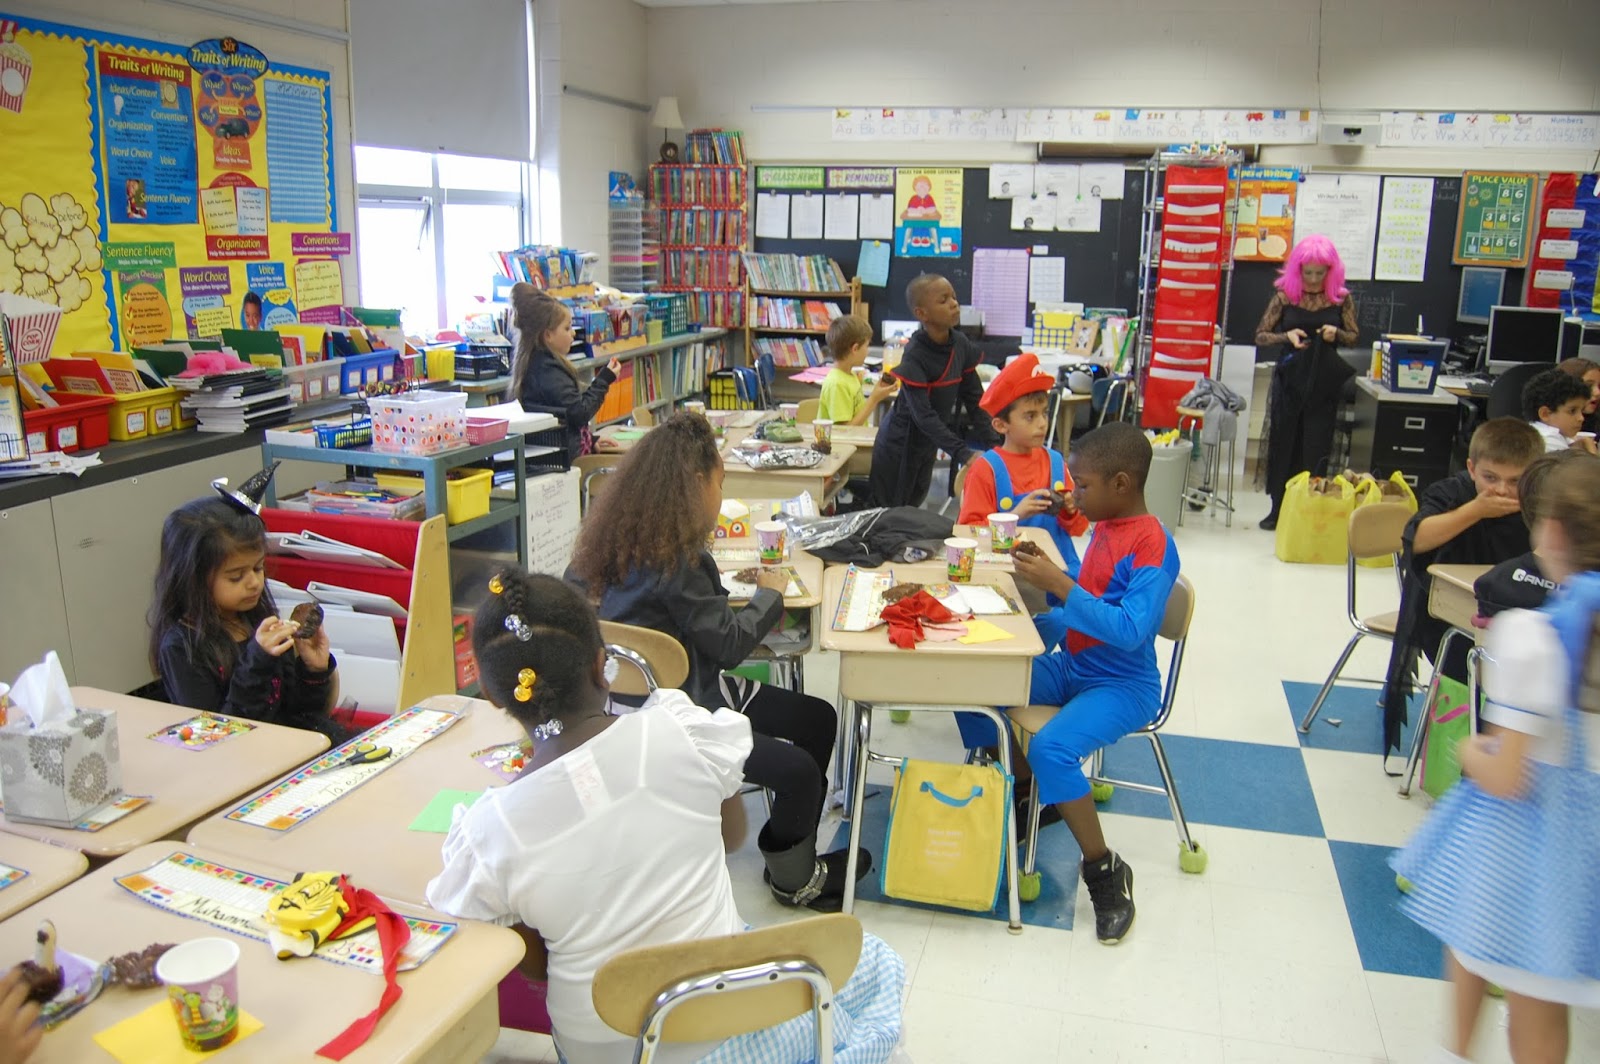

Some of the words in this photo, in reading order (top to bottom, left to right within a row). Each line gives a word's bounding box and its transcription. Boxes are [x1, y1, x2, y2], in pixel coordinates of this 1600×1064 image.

[223, 37, 236, 52] Six
[192, 48, 220, 65] Traits
[222, 54, 230, 68] of
[231, 54, 266, 72] Writing
[108, 55, 140, 72] Traits
[141, 64, 150, 75] of
[151, 62, 185, 82] Writing
[204, 78, 224, 89] What?
[232, 82, 254, 92] Where?
[110, 83, 158, 98] Ideas/Content
[151, 109, 188, 122] Conventions
[1550, 116, 1583, 125] Numbers
[108, 118, 154, 132] Organization
[836, 122, 852, 135] Aa
[860, 123, 875, 135] Bb
[882, 123, 897, 135] Cc
[904, 122, 919, 135] Dd
[928, 123, 940, 135] Ee
[996, 124, 1012, 135] Hh
[1070, 125, 1083, 136] Kk
[1119, 126, 1141, 137] Mm
[1146, 126, 1162, 137] Nn
[1168, 126, 1186, 137] Oo
[1192, 126, 1208, 139] Pp
[1219, 126, 1239, 138] Qq
[1274, 126, 1287, 136] Ss
[1385, 128, 1400, 141] Uu
[1411, 129, 1427, 141] Vv
[1435, 129, 1456, 141] Ww
[1460, 129, 1479, 141] Xx
[1489, 128, 1507, 144] Yy
[1513, 128, 1530, 141] Zz
[111, 146, 128, 157] Word
[131, 148, 153, 159] Choice
[222, 144, 241, 156] Ideas
[160, 156, 176, 166] Voice
[772, 171, 797, 181] CLASS
[798, 171, 820, 181] NEWS
[845, 172, 890, 183] REMINDERS
[1233, 169, 1254, 178] Tpes
[1264, 168, 1293, 178] Writing
[1472, 176, 1499, 184] PLACE
[1501, 176, 1528, 185] VALUE
[140, 192, 168, 203] Sentence
[170, 194, 191, 204] Fluency
[1502, 189, 1510, 198] 8
[1515, 190, 1523, 198] 6
[58, 206, 82, 223] before
[1485, 212, 1493, 221] 3
[1499, 213, 1507, 222] 8
[1512, 214, 1520, 222] 6
[216, 238, 261, 250] Organization
[303, 234, 339, 246] Conventions
[1482, 237, 1490, 246] 3
[1496, 238, 1503, 246] 8
[1508, 238, 1517, 247] 6
[106, 245, 142, 257] Sentence
[144, 245, 172, 257] Fluency
[259, 265, 275, 275] Voice
[184, 272, 203, 283] Word
[205, 271, 227, 282] Choice
[185, 895, 262, 932] Muhamm
